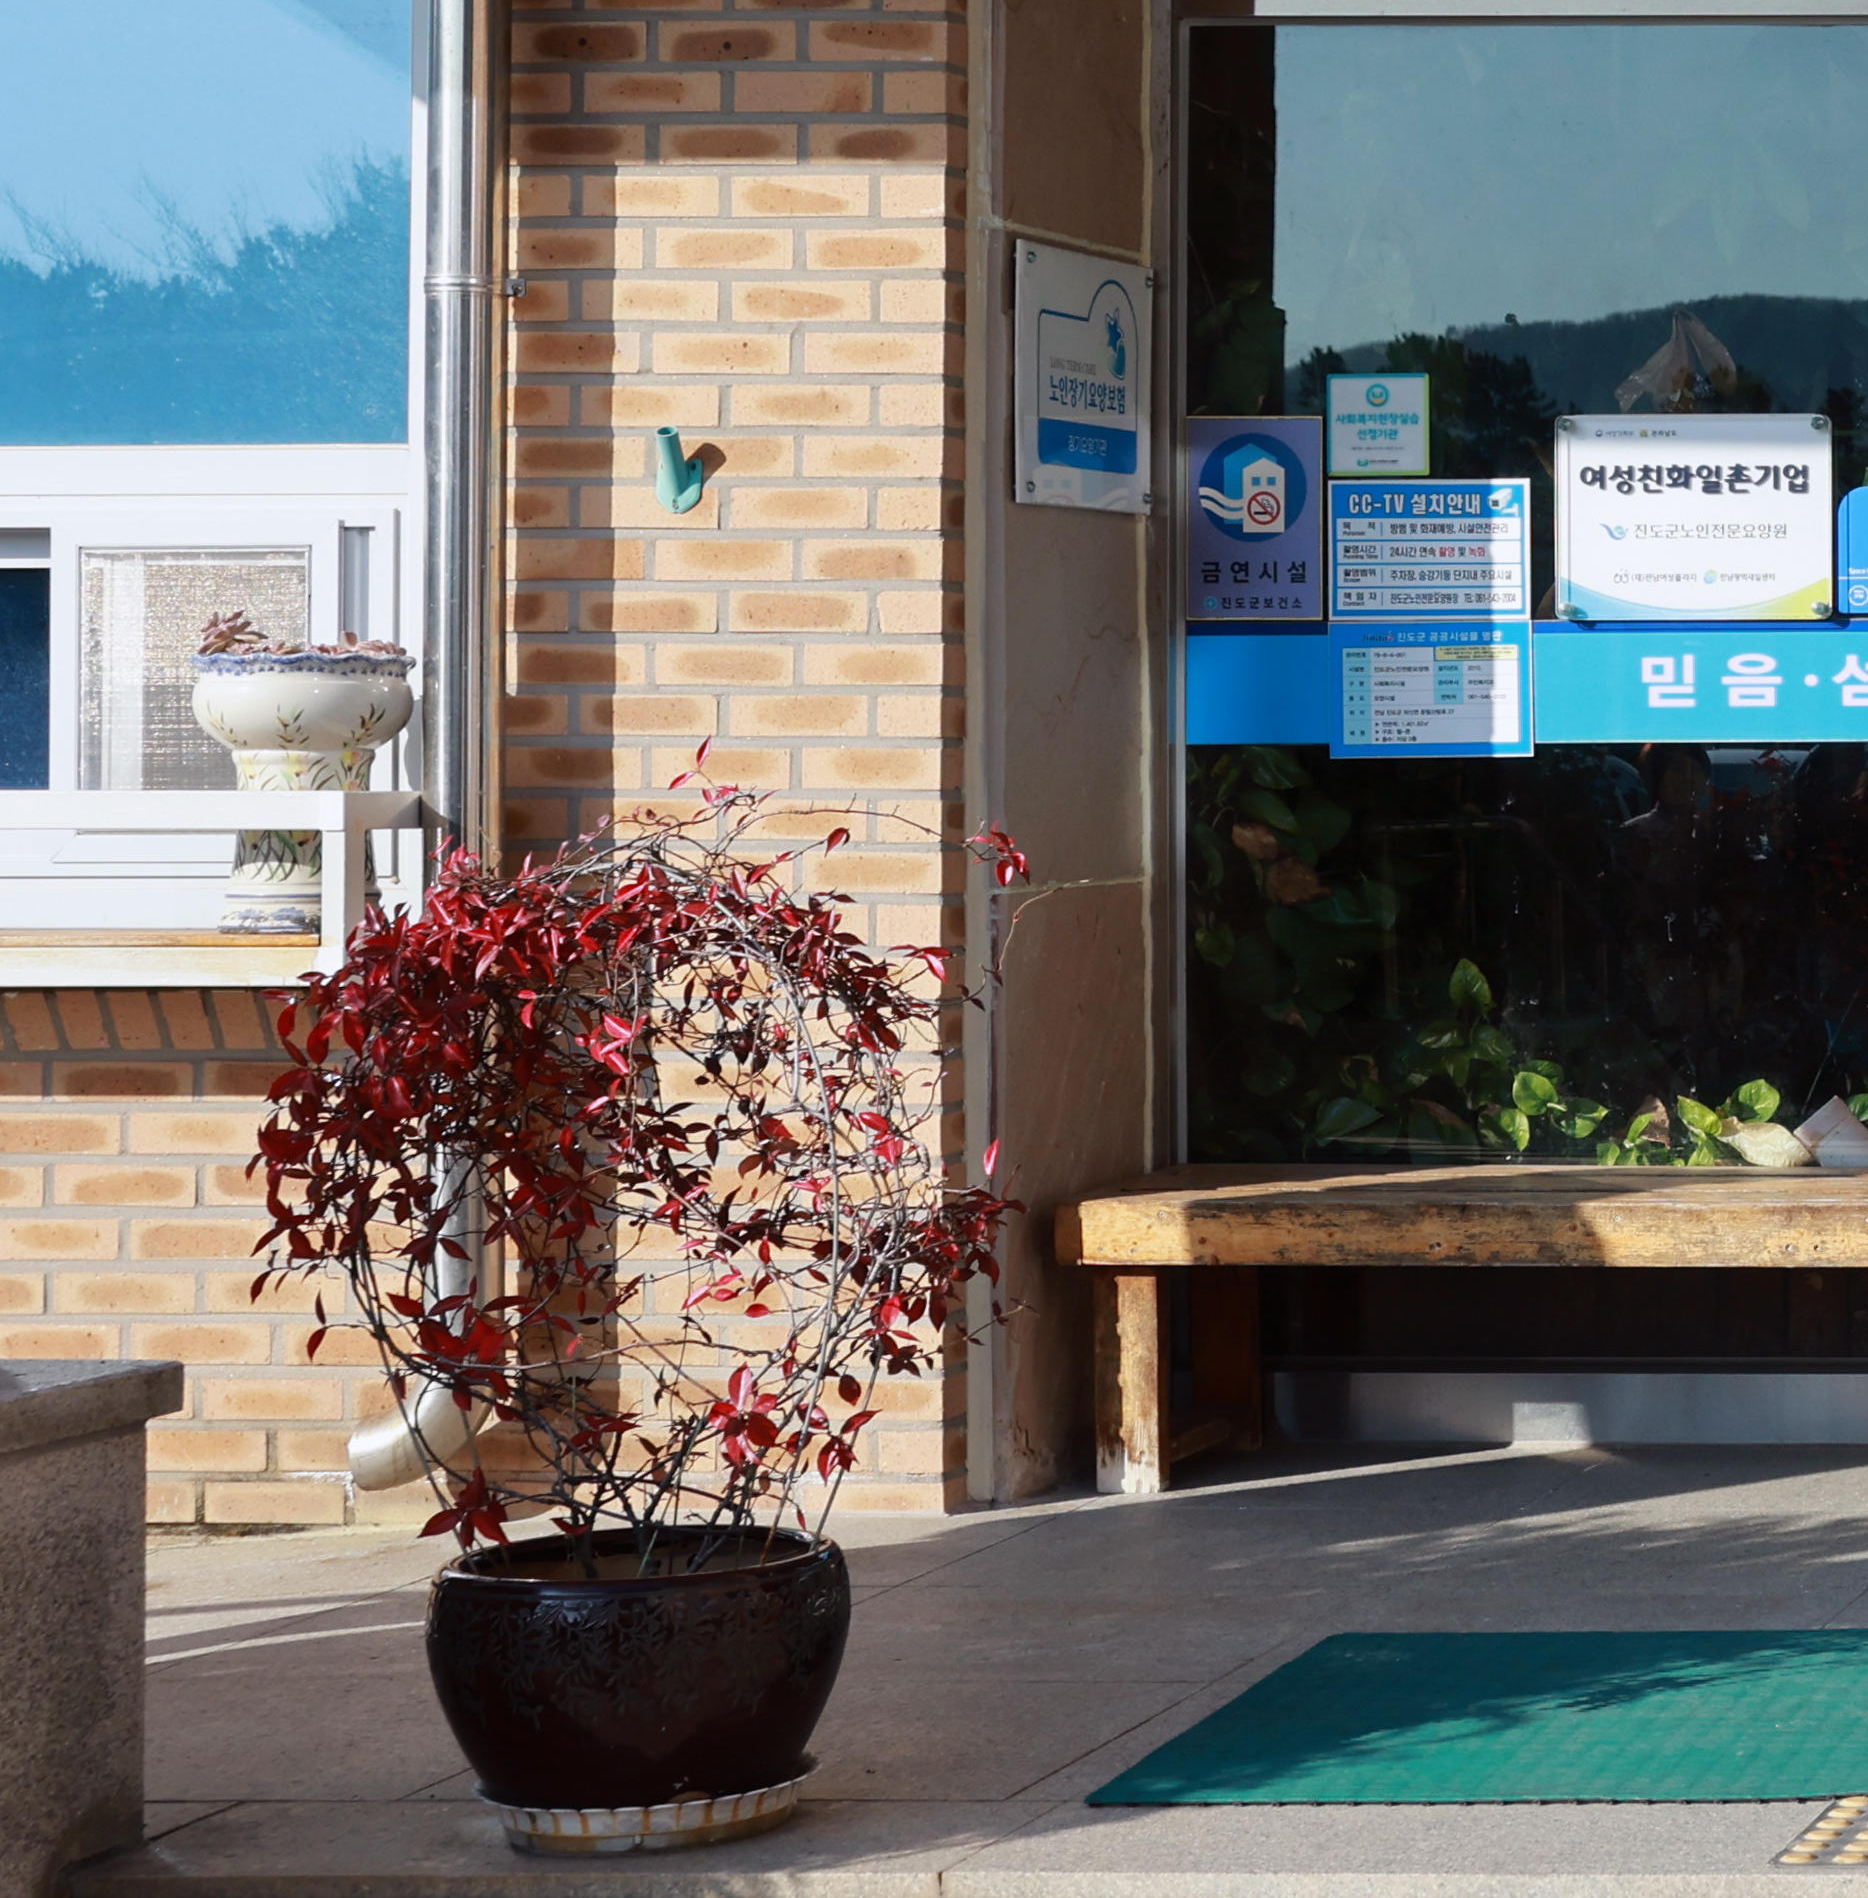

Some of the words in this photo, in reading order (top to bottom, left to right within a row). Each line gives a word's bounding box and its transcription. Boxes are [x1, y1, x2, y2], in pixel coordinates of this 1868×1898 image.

[1049, 375, 1126, 414] 노인장기요양보험
[1580, 464, 1810, 494] 여성친화일촌기업
[1349, 493, 1405, 514] CC-TV
[1633, 523, 1787, 540] 진도군노인전문요양원
[1201, 560, 1307, 584] 금연시설
[1221, 597, 1303, 610] 진도군보건소
